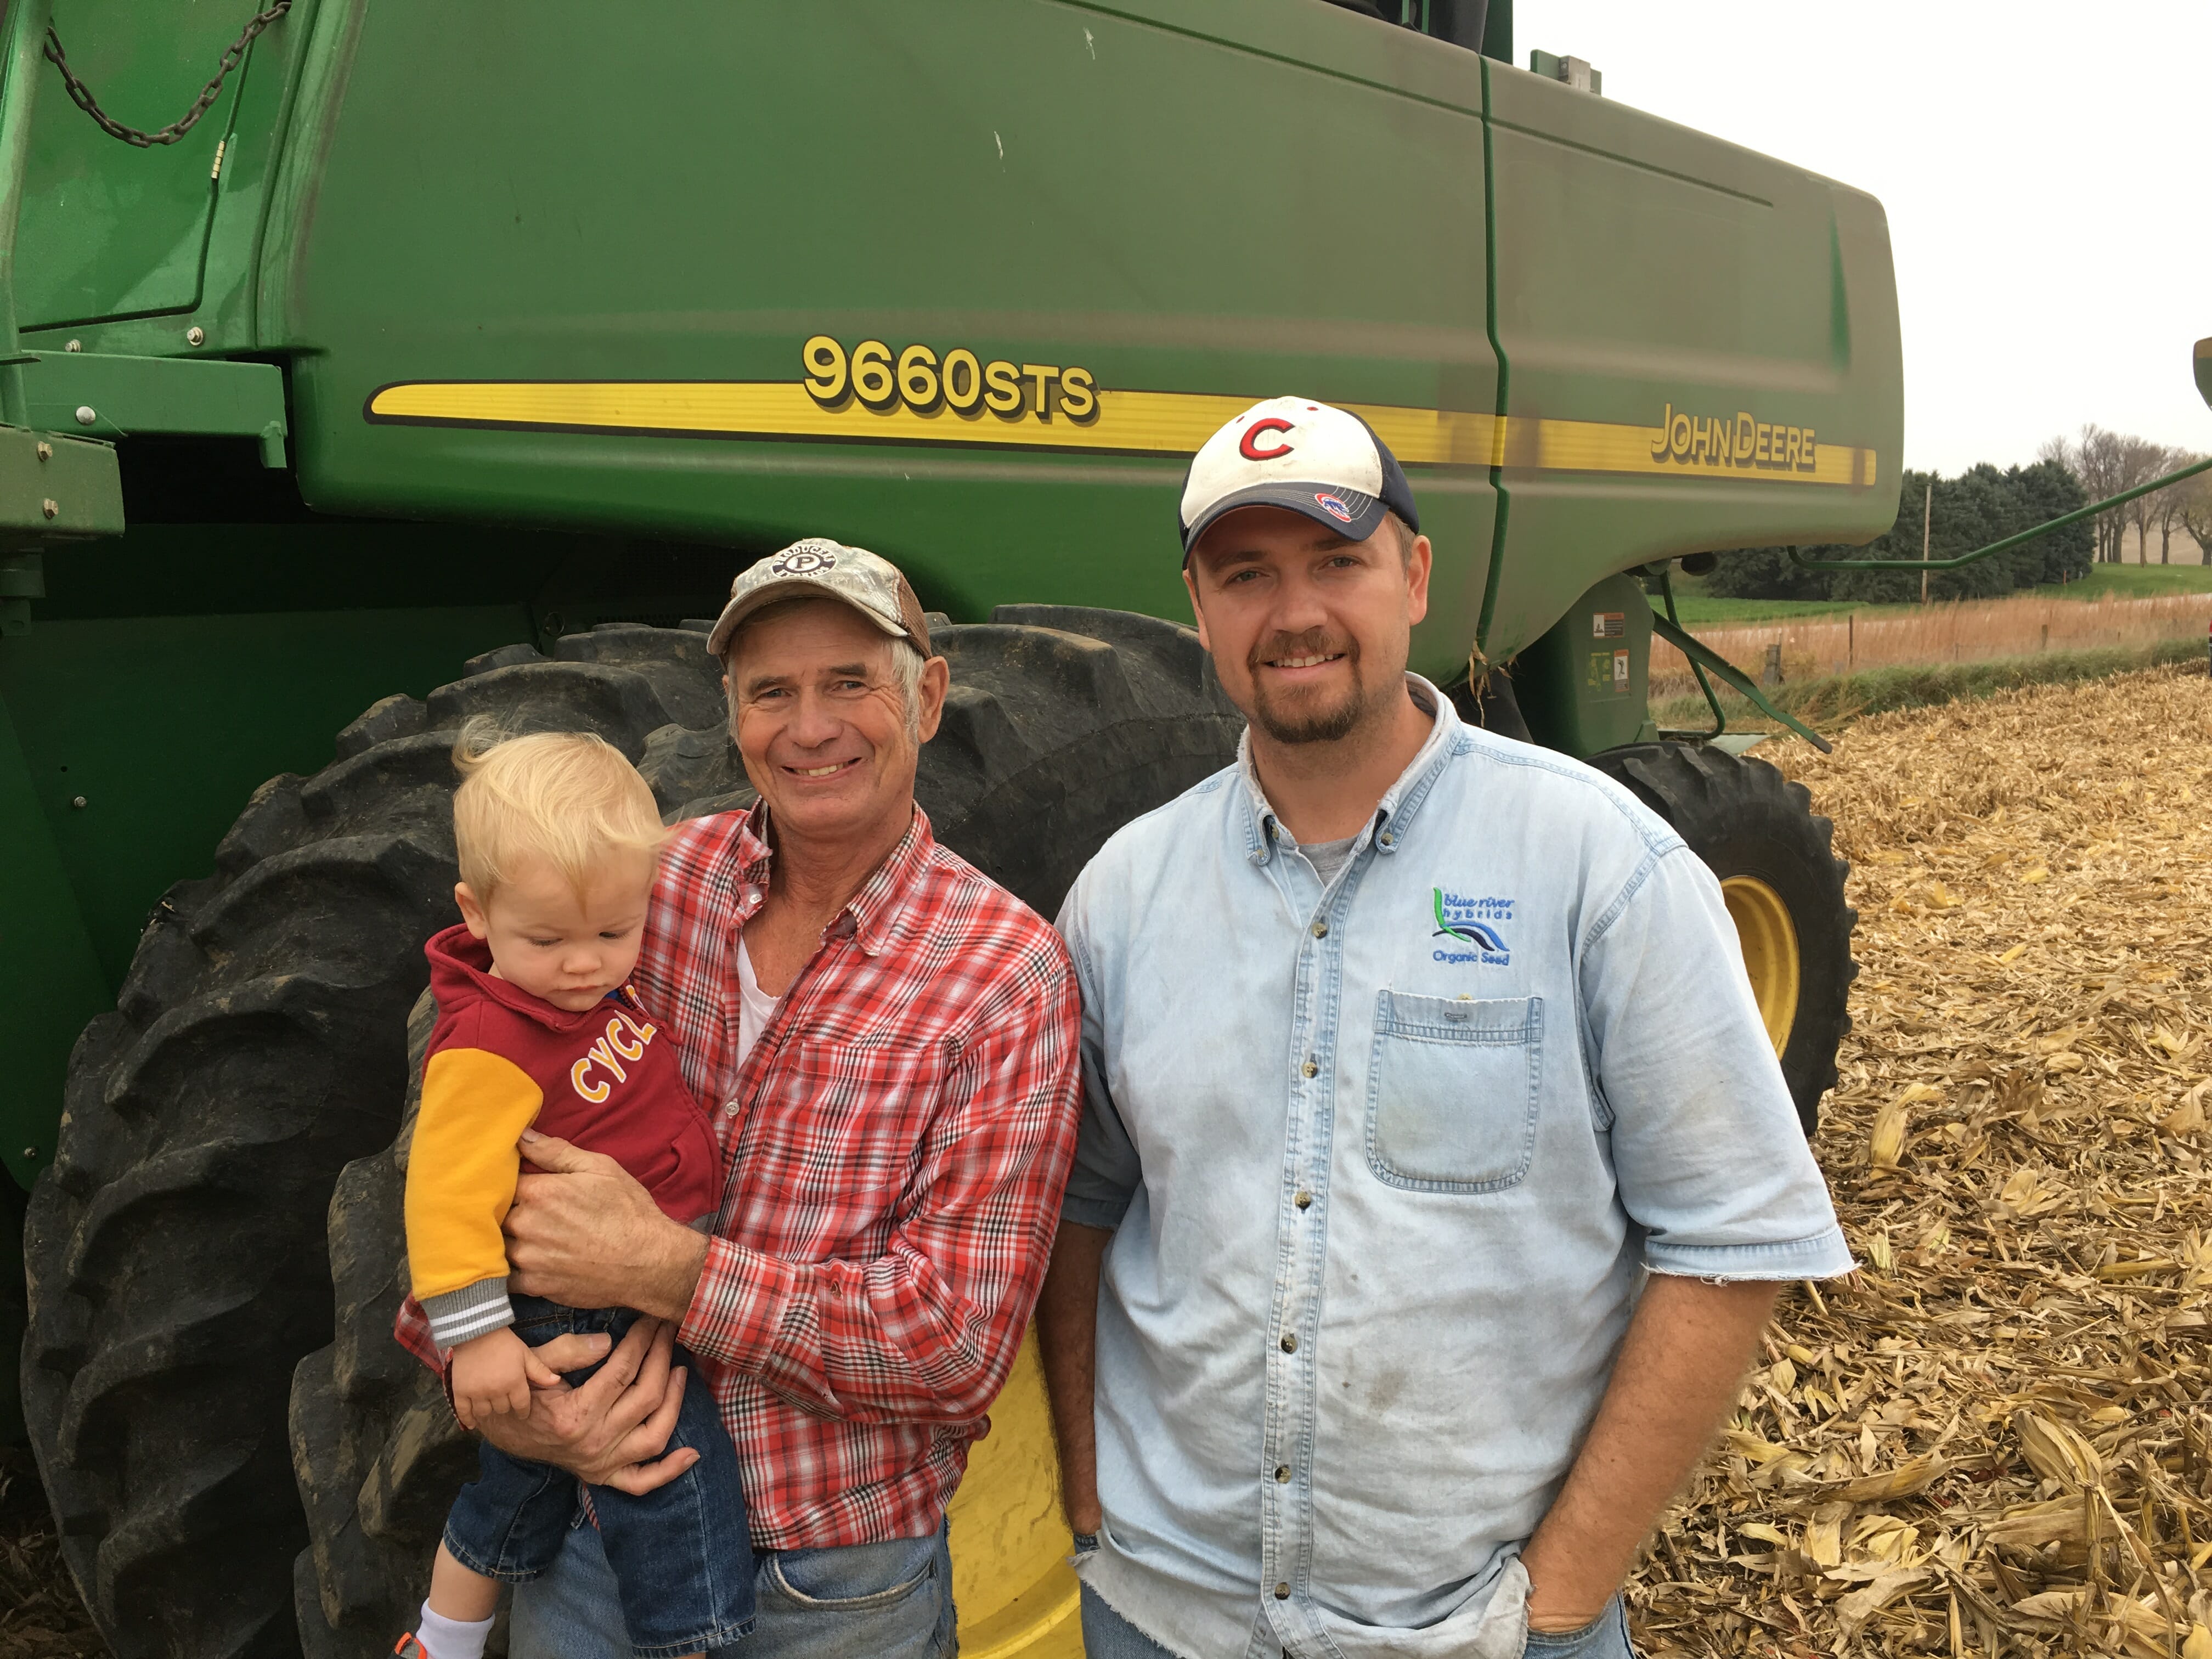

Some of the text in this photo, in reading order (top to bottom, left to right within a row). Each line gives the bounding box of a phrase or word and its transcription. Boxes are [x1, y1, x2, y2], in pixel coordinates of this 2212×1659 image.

[1239, 417, 1295, 461] C
[772, 545, 836, 566] PRODUCERS
[794, 556, 815, 569] P
[1444, 893, 1515, 908] blue river
[1443, 908, 1513, 920] hybrids
[1432, 950, 1510, 966] Organic Seed
